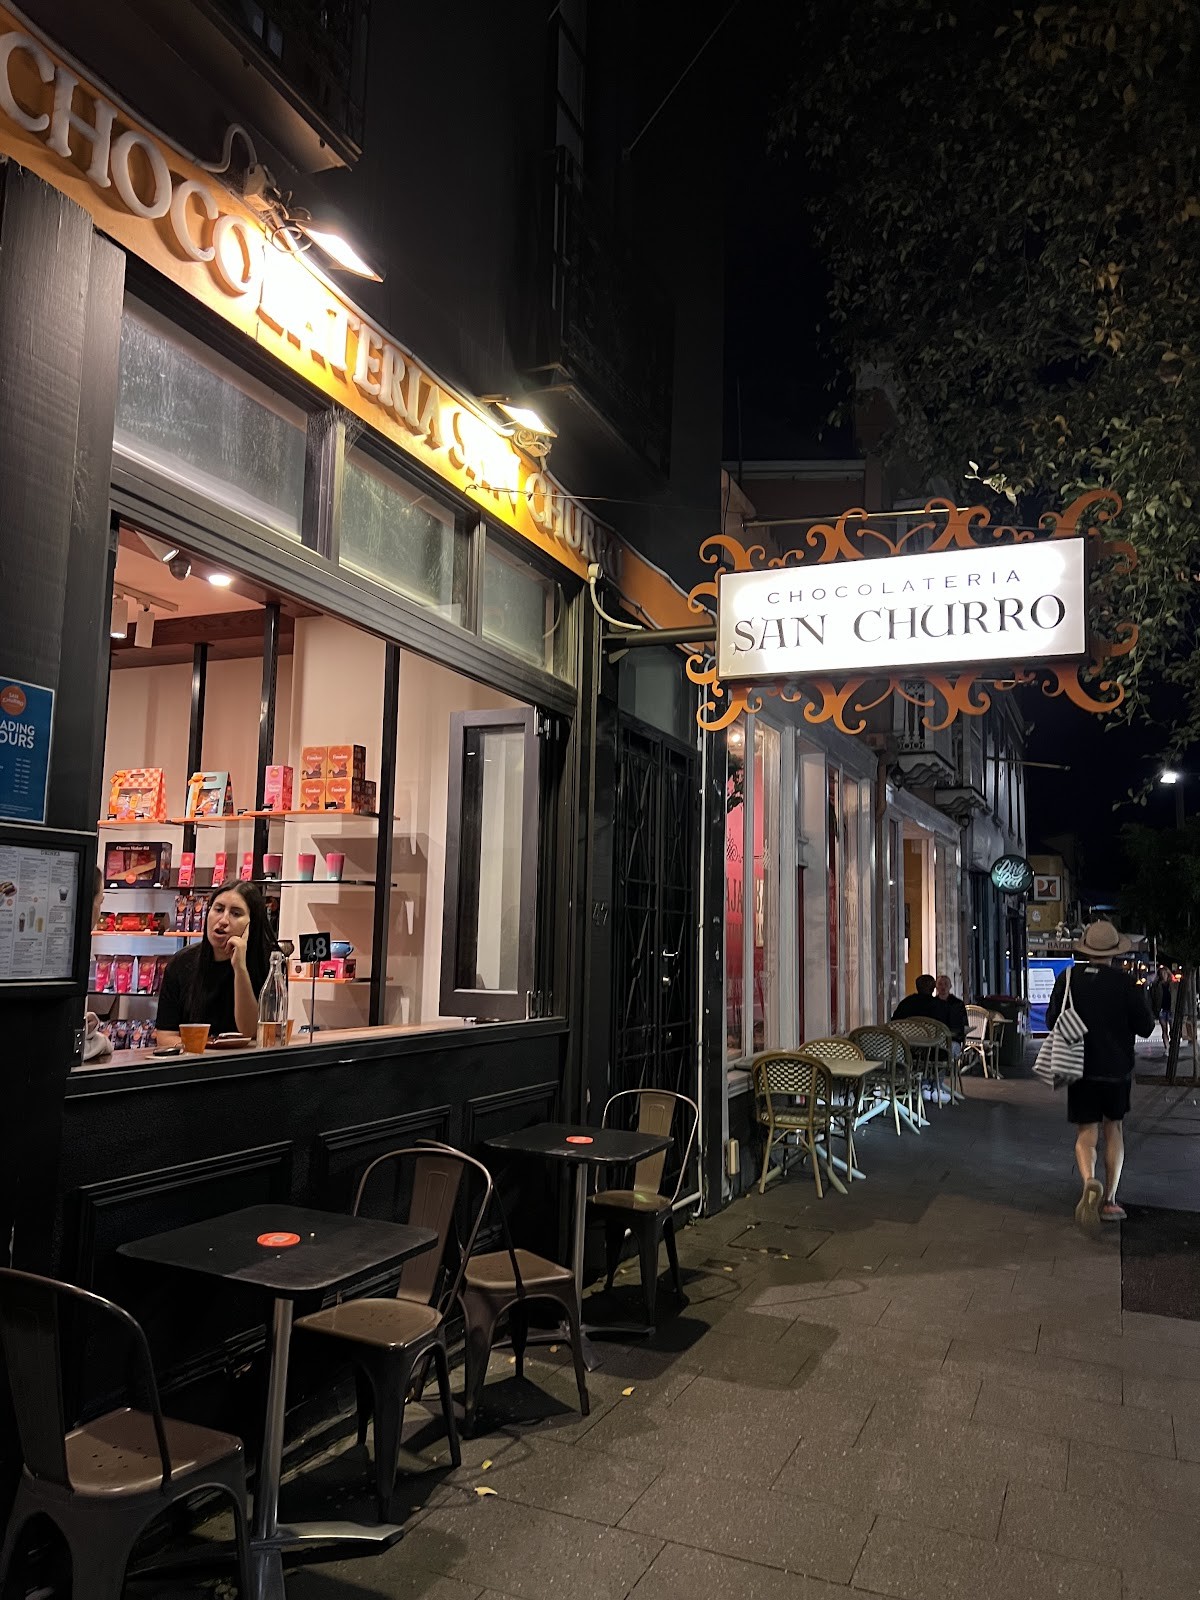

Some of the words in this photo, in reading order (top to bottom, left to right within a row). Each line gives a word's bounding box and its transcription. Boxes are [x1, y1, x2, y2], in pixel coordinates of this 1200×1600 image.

[767, 569, 1021, 605] CHOCOLATERIA
[732, 613, 828, 656] SAN
[853, 594, 1066, 643] CHURRO
[995, 860, 1028, 879] Dirty
[304, 937, 327, 958] 48
